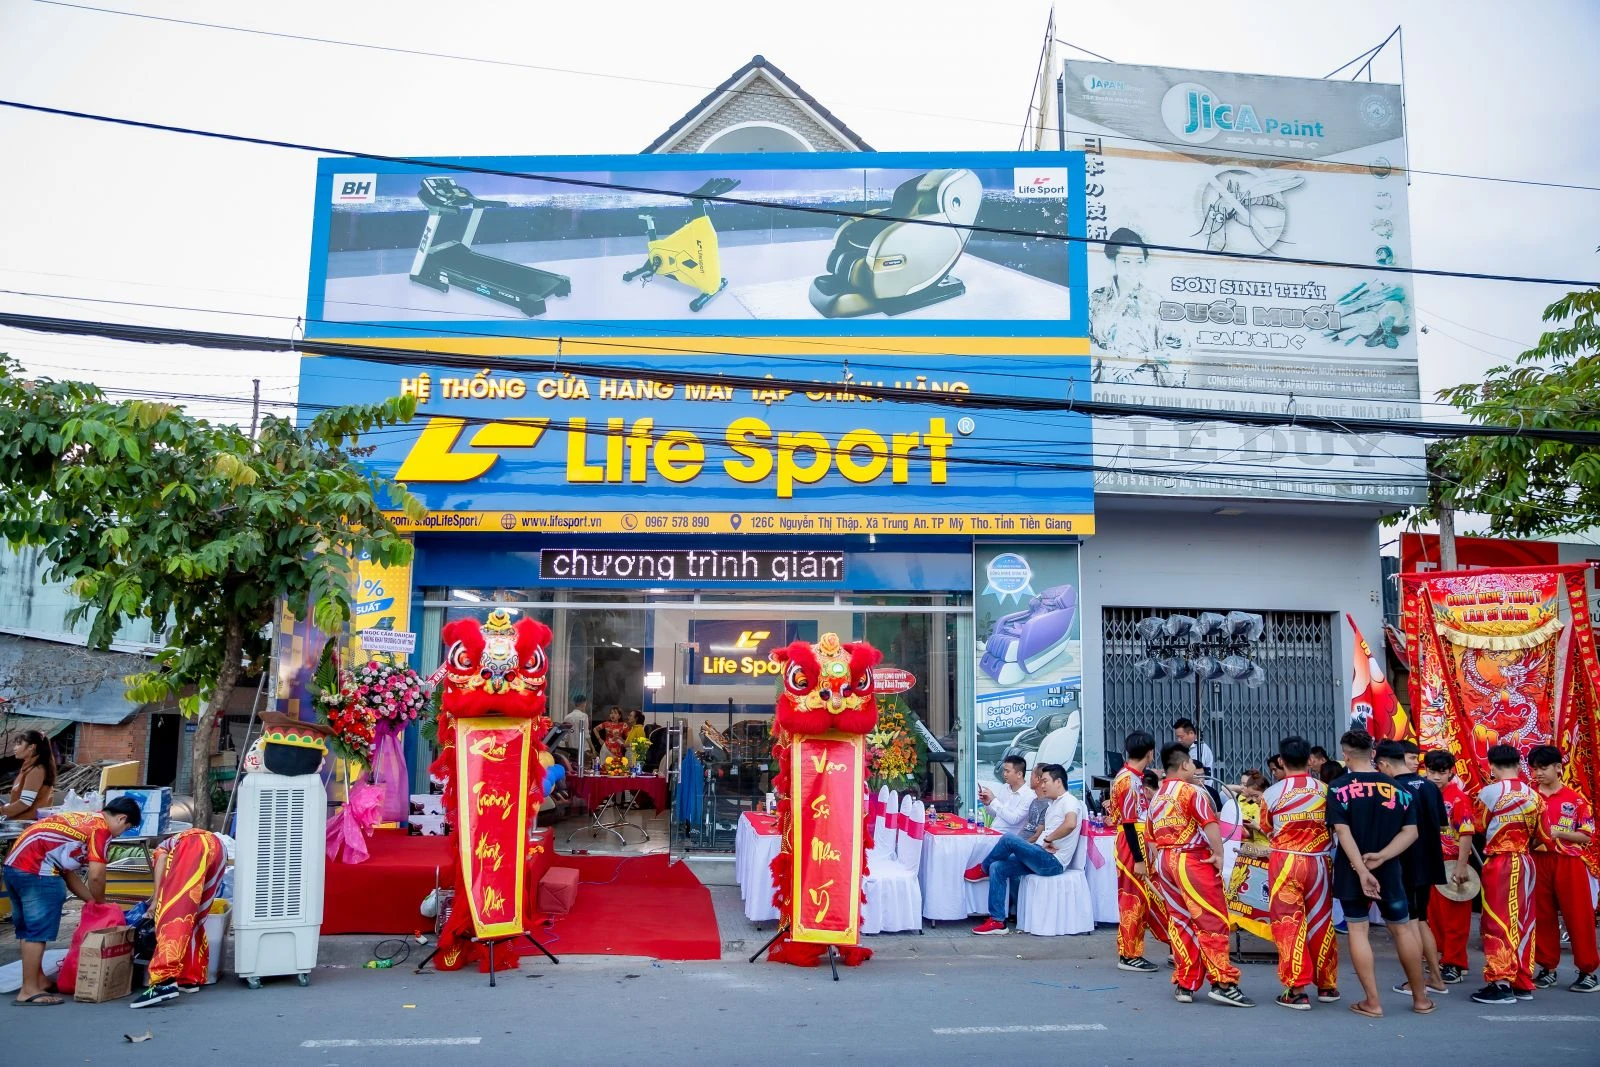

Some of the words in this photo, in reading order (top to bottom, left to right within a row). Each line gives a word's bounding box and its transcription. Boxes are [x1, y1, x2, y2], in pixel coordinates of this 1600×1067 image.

[1265, 118, 1325, 137] Paint
[341, 181, 371, 195] BH
[1018, 185, 1036, 194] Life
[1037, 185, 1065, 196] Sport
[1171, 276, 1216, 293] SƠN
[1219, 279, 1272, 297] SINH
[1275, 281, 1327, 300] THÁI
[401, 372, 431, 404] HỆ
[440, 367, 527, 399] THỐNG
[537, 371, 591, 400] CỬA
[1207, 375, 1227, 386] CÔNG
[567, 417, 705, 482] Life
[723, 416, 953, 498] Sport
[521, 515, 602, 529] www.lifesport.vn
[645, 516, 668, 528] 0967
[672, 516, 689, 528] 578
[692, 516, 710, 528] 890
[751, 516, 774, 528] 126C
[780, 514, 814, 531] Nguyễn
[818, 516, 832, 531] Thị
[866, 516, 878, 528] Xã
[882, 517, 909, 531] Trung
[950, 517, 964, 531] Mỹ
[1045, 517, 1072, 532] Giang
[553, 550, 674, 580] chương
[687, 550, 758, 578] trình
[703, 656, 737, 674] Life
[988, 707, 1011, 716] Sang
